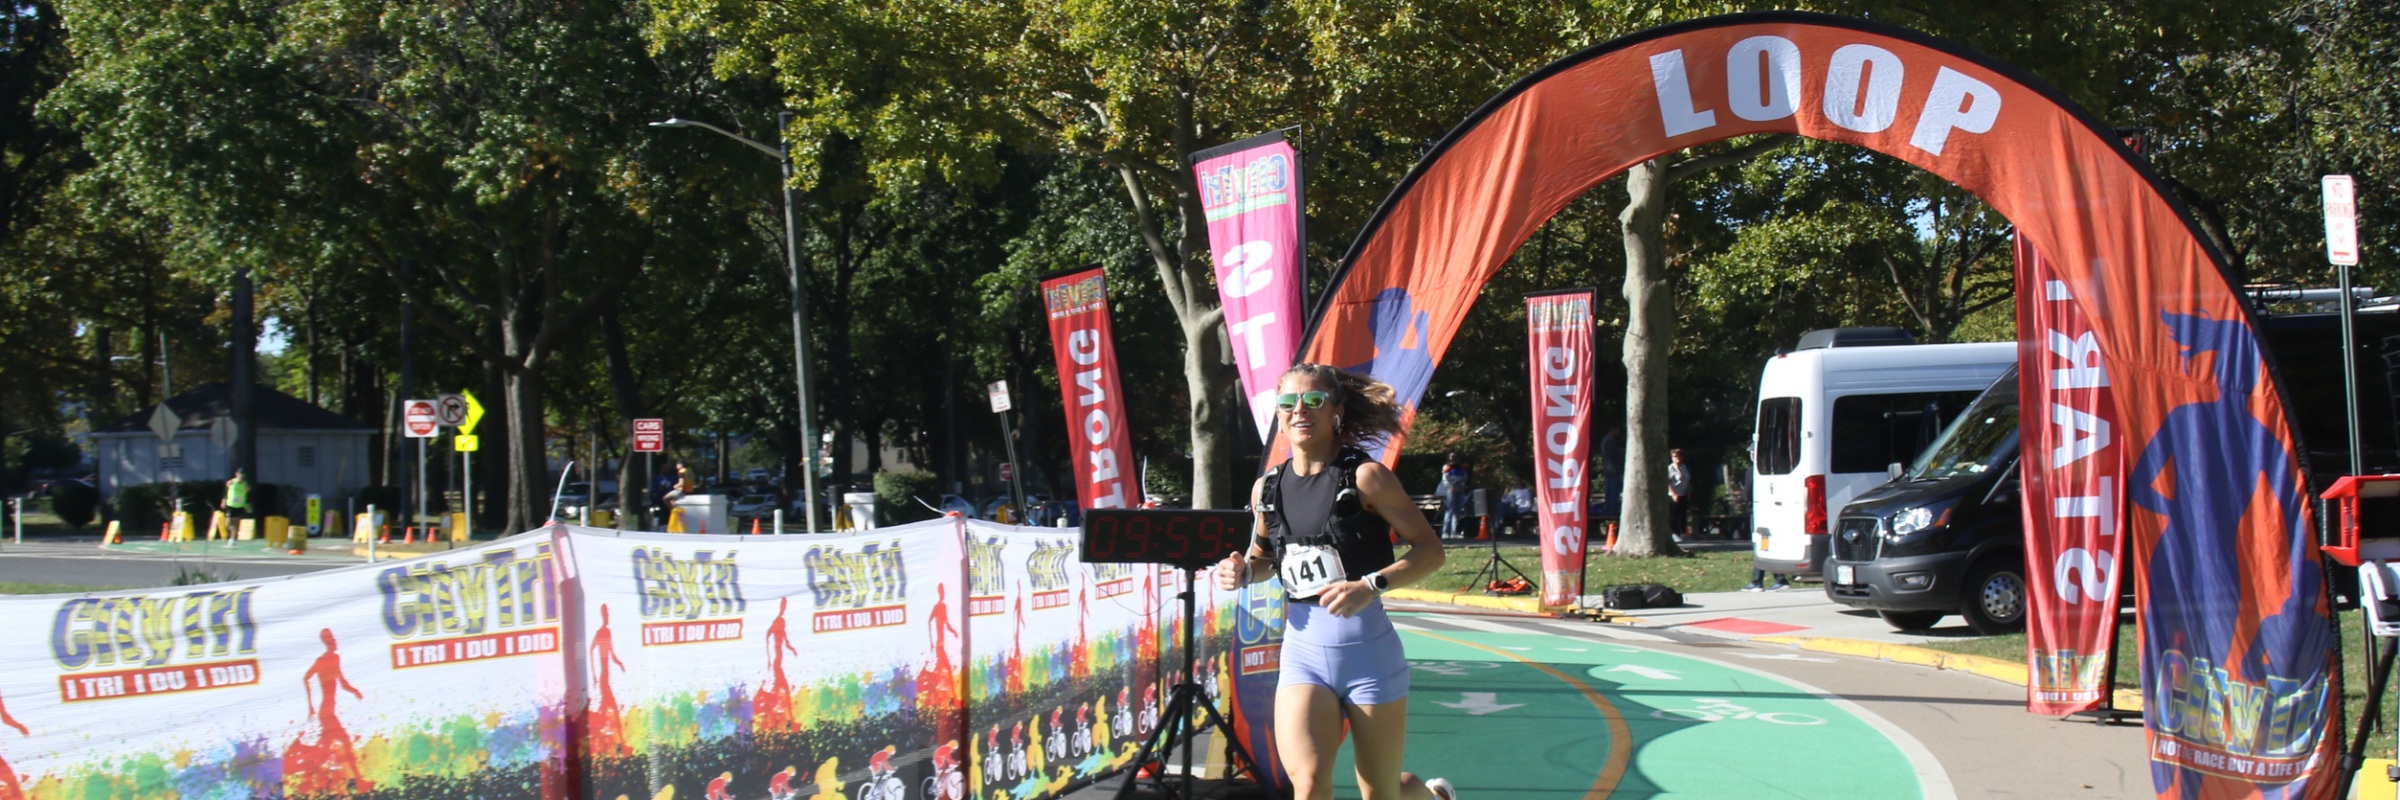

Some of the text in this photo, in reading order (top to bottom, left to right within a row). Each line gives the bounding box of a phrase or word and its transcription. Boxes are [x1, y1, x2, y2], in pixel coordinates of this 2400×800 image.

[1649, 35, 2001, 157] LOOP
[2332, 182, 2343, 198] NO
[2325, 202, 2353, 218] PARKING
[637, 422, 660, 430] CARS
[631, 546, 747, 620] CityTri
[1288, 556, 1327, 585] 141
[377, 541, 559, 639] CityTri
[51, 586, 258, 670] CityTri
[652, 626, 674, 643] TRI
[396, 632, 554, 666] I TRI I DU I DID
[1244, 651, 1265, 667] NOT
[65, 664, 256, 699] I TRI I DU I DID
[2155, 649, 2328, 756] CityTri
[2158, 739, 2181, 757] NOT
[2194, 750, 2225, 769] RACE
[2227, 758, 2254, 773] BUT
[2255, 762, 2266, 776] A
[2268, 761, 2292, 776] LIFE
